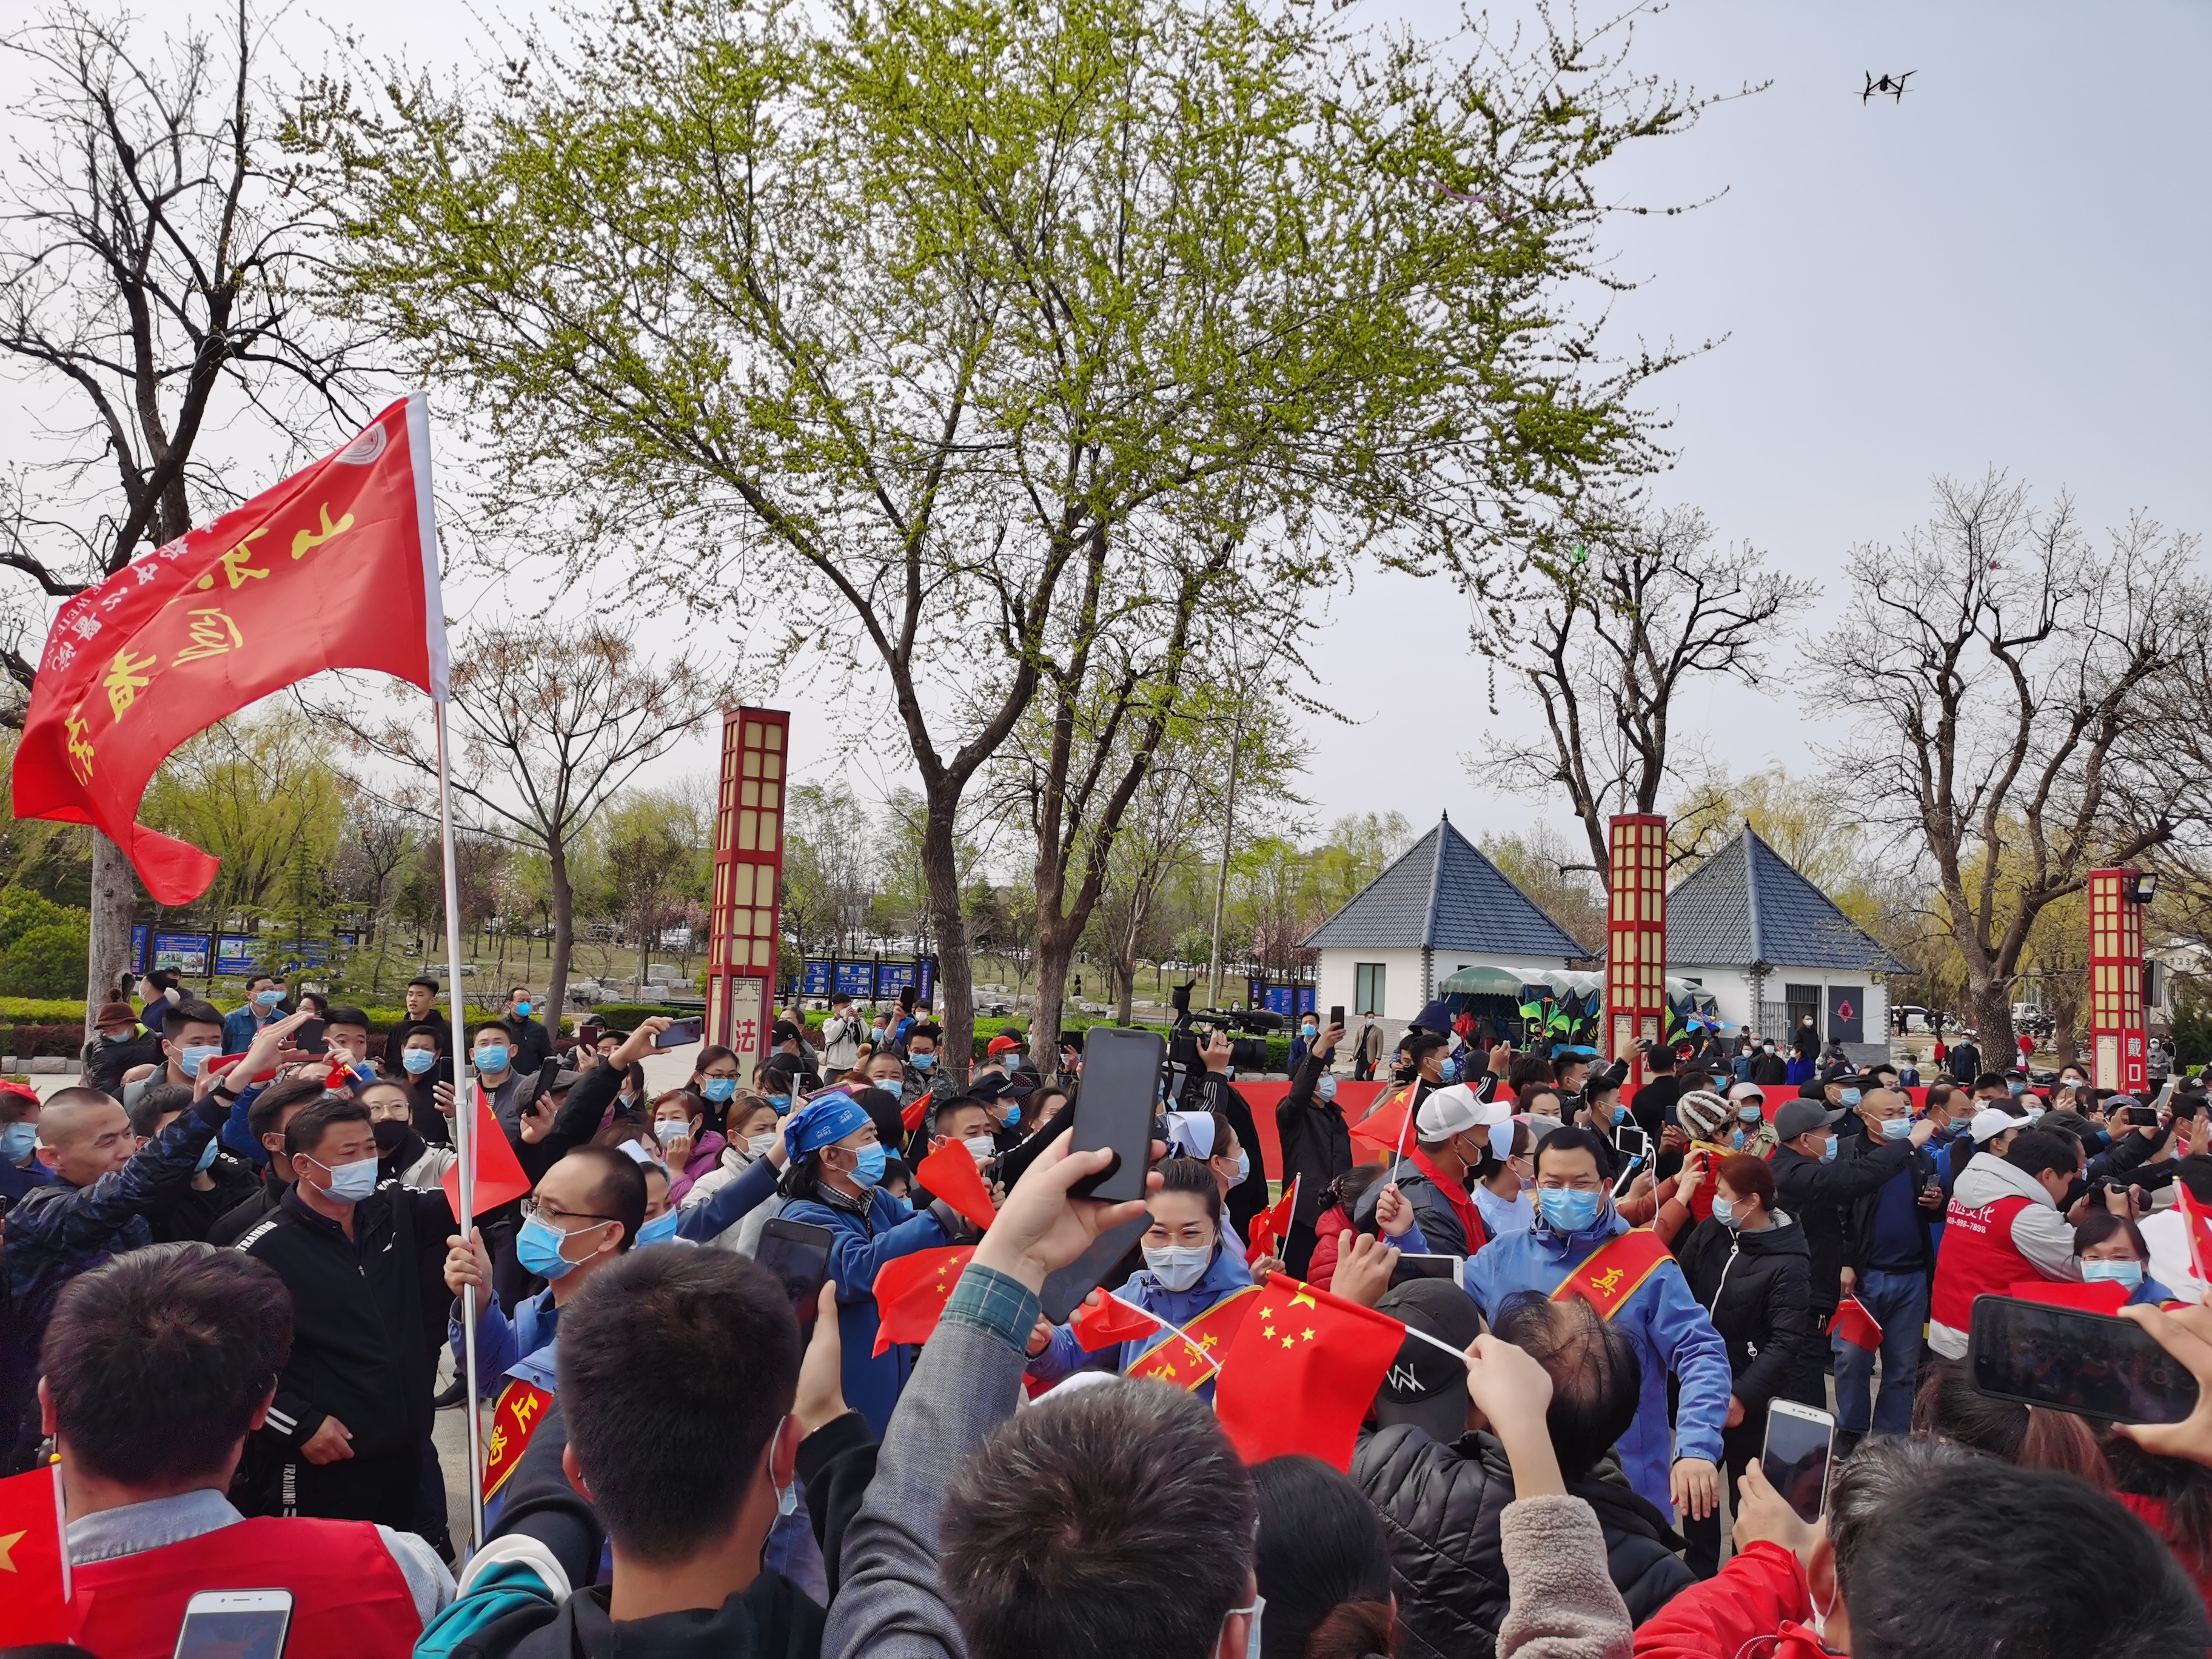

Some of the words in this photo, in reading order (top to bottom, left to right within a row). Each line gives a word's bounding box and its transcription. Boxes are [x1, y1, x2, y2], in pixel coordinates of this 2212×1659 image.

[735, 1019, 756, 1053] 法
[235, 1221, 278, 1252] TRAINING
[1590, 1267, 1624, 1298] 真
[489, 1392, 538, 1466] 正的
[283, 1463, 296, 1504] TRAINING
